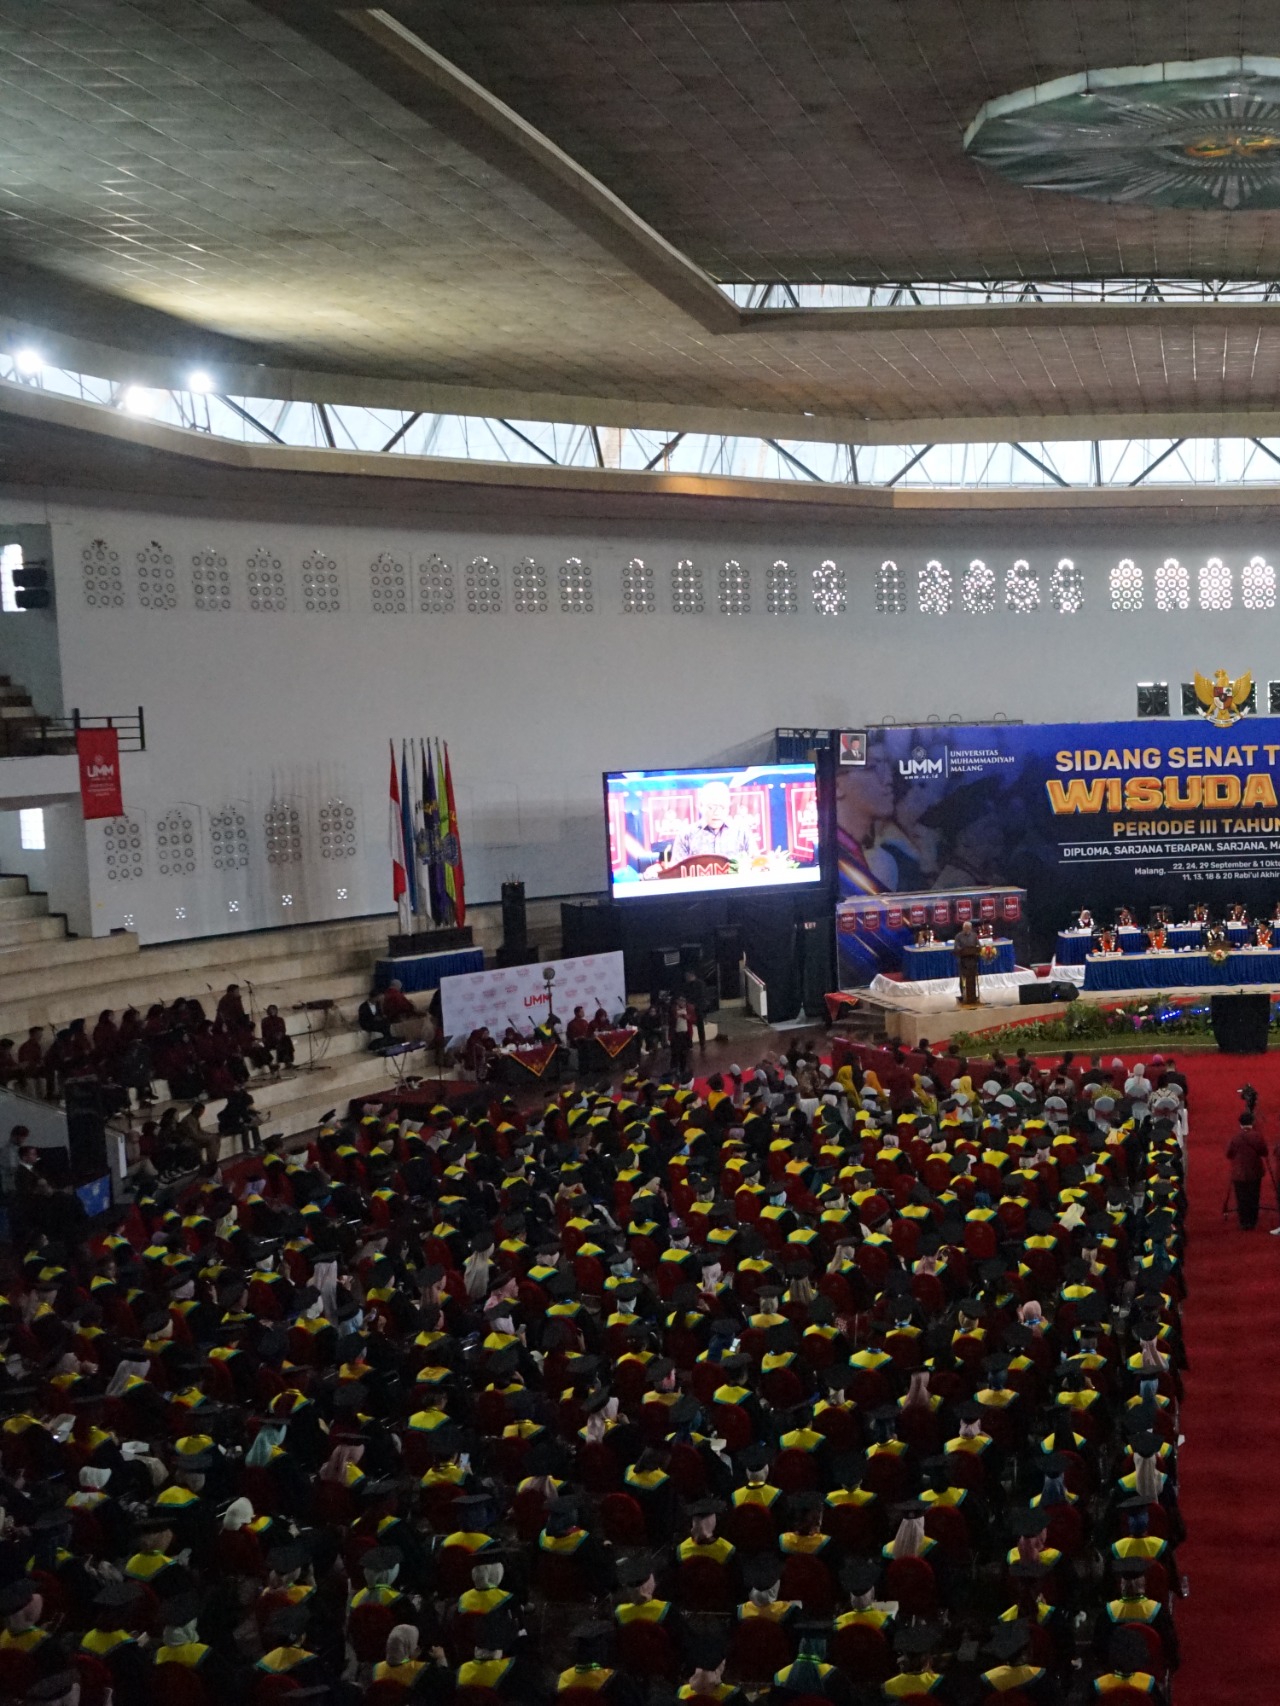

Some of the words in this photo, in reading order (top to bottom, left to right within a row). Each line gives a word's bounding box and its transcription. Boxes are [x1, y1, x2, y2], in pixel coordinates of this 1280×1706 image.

[950, 749, 999, 757] UNIVERSITAS
[1055, 748, 1161, 772] SIDANG
[1168, 745, 1258, 769] SENAT
[87, 764, 114, 777] UMM
[899, 759, 942, 775] UMM
[950, 756, 1015, 765] MUHAMMADIYAH
[950, 764, 983, 772] MALANG
[1046, 774, 1278, 815] WISUDA
[1113, 820, 1195, 837] PERIODE
[1200, 819, 1217, 834] III
[1063, 847, 1112, 857] DIPLOMA,
[1114, 845, 1163, 855] SARJANA
[1164, 843, 1214, 853] TERAPAN,
[1216, 841, 1267, 851] SARJANA,
[1134, 867, 1166, 876] Malang,
[1210, 861, 1251, 870] September
[1259, 860, 1264, 868] 1
[1234, 871, 1259, 879] Rabi'ul
[1260, 870, 1280, 878] Akhir
